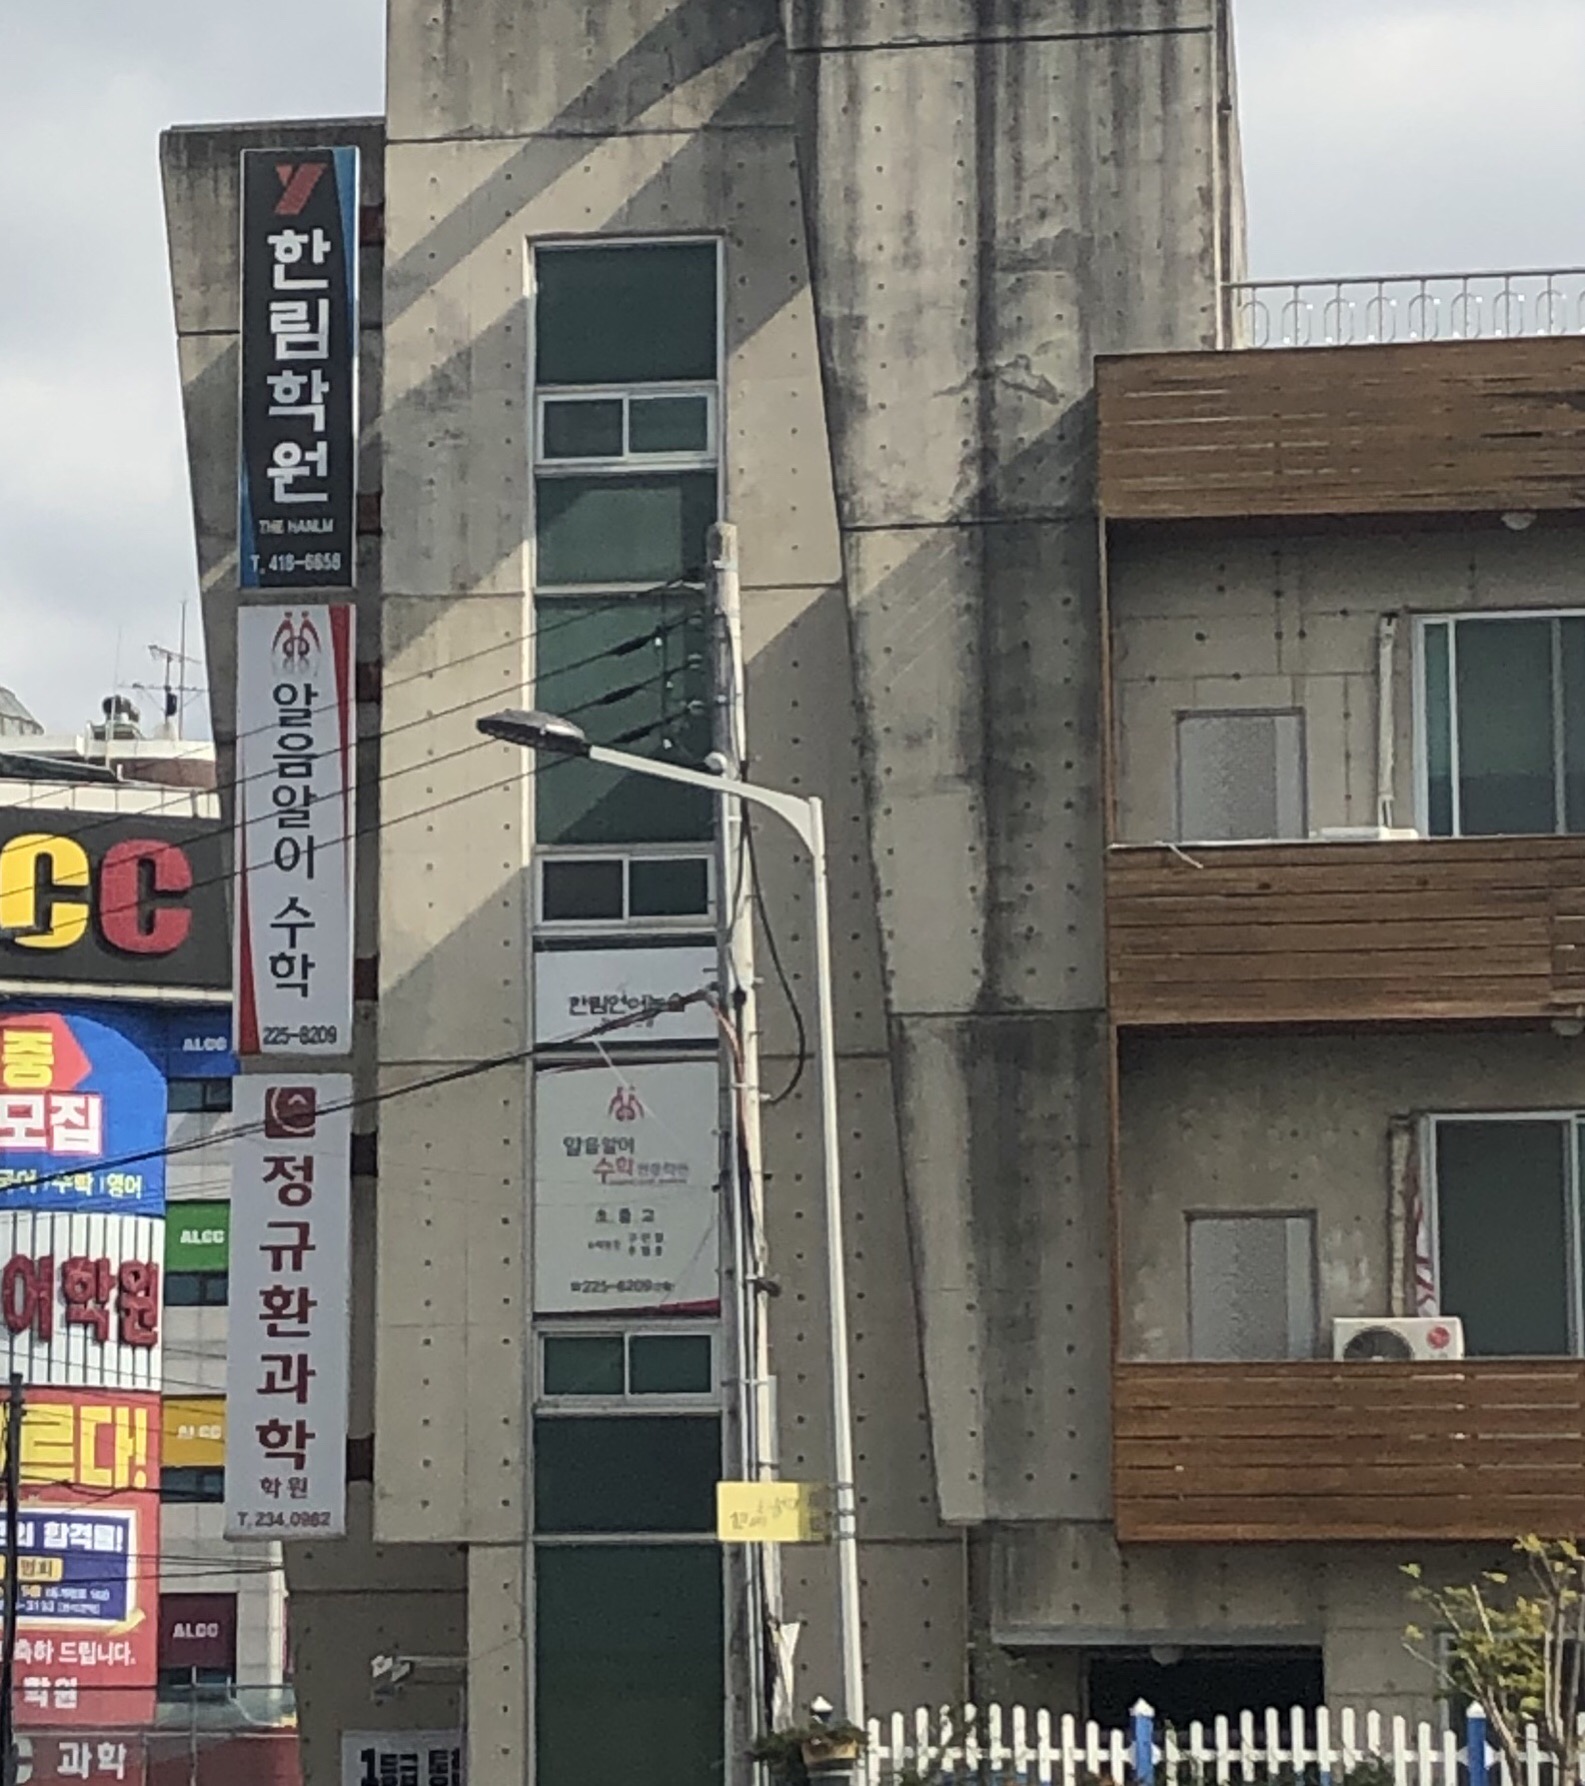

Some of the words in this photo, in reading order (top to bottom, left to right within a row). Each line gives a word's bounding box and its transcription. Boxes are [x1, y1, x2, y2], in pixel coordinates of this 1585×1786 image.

[266, 227, 332, 503] 한림학원
[271, 683, 319, 879] 알음알이
[269, 897, 316, 998] 수학
[0, 1093, 102, 1153] 모집
[107, 1172, 143, 1200] 영어
[255, 1155, 317, 1471] 정규환과학
[259, 1477, 308, 1499] 학원
[58, 1640, 137, 1667] 드립니다.
[57, 1741, 127, 1780] 과학
